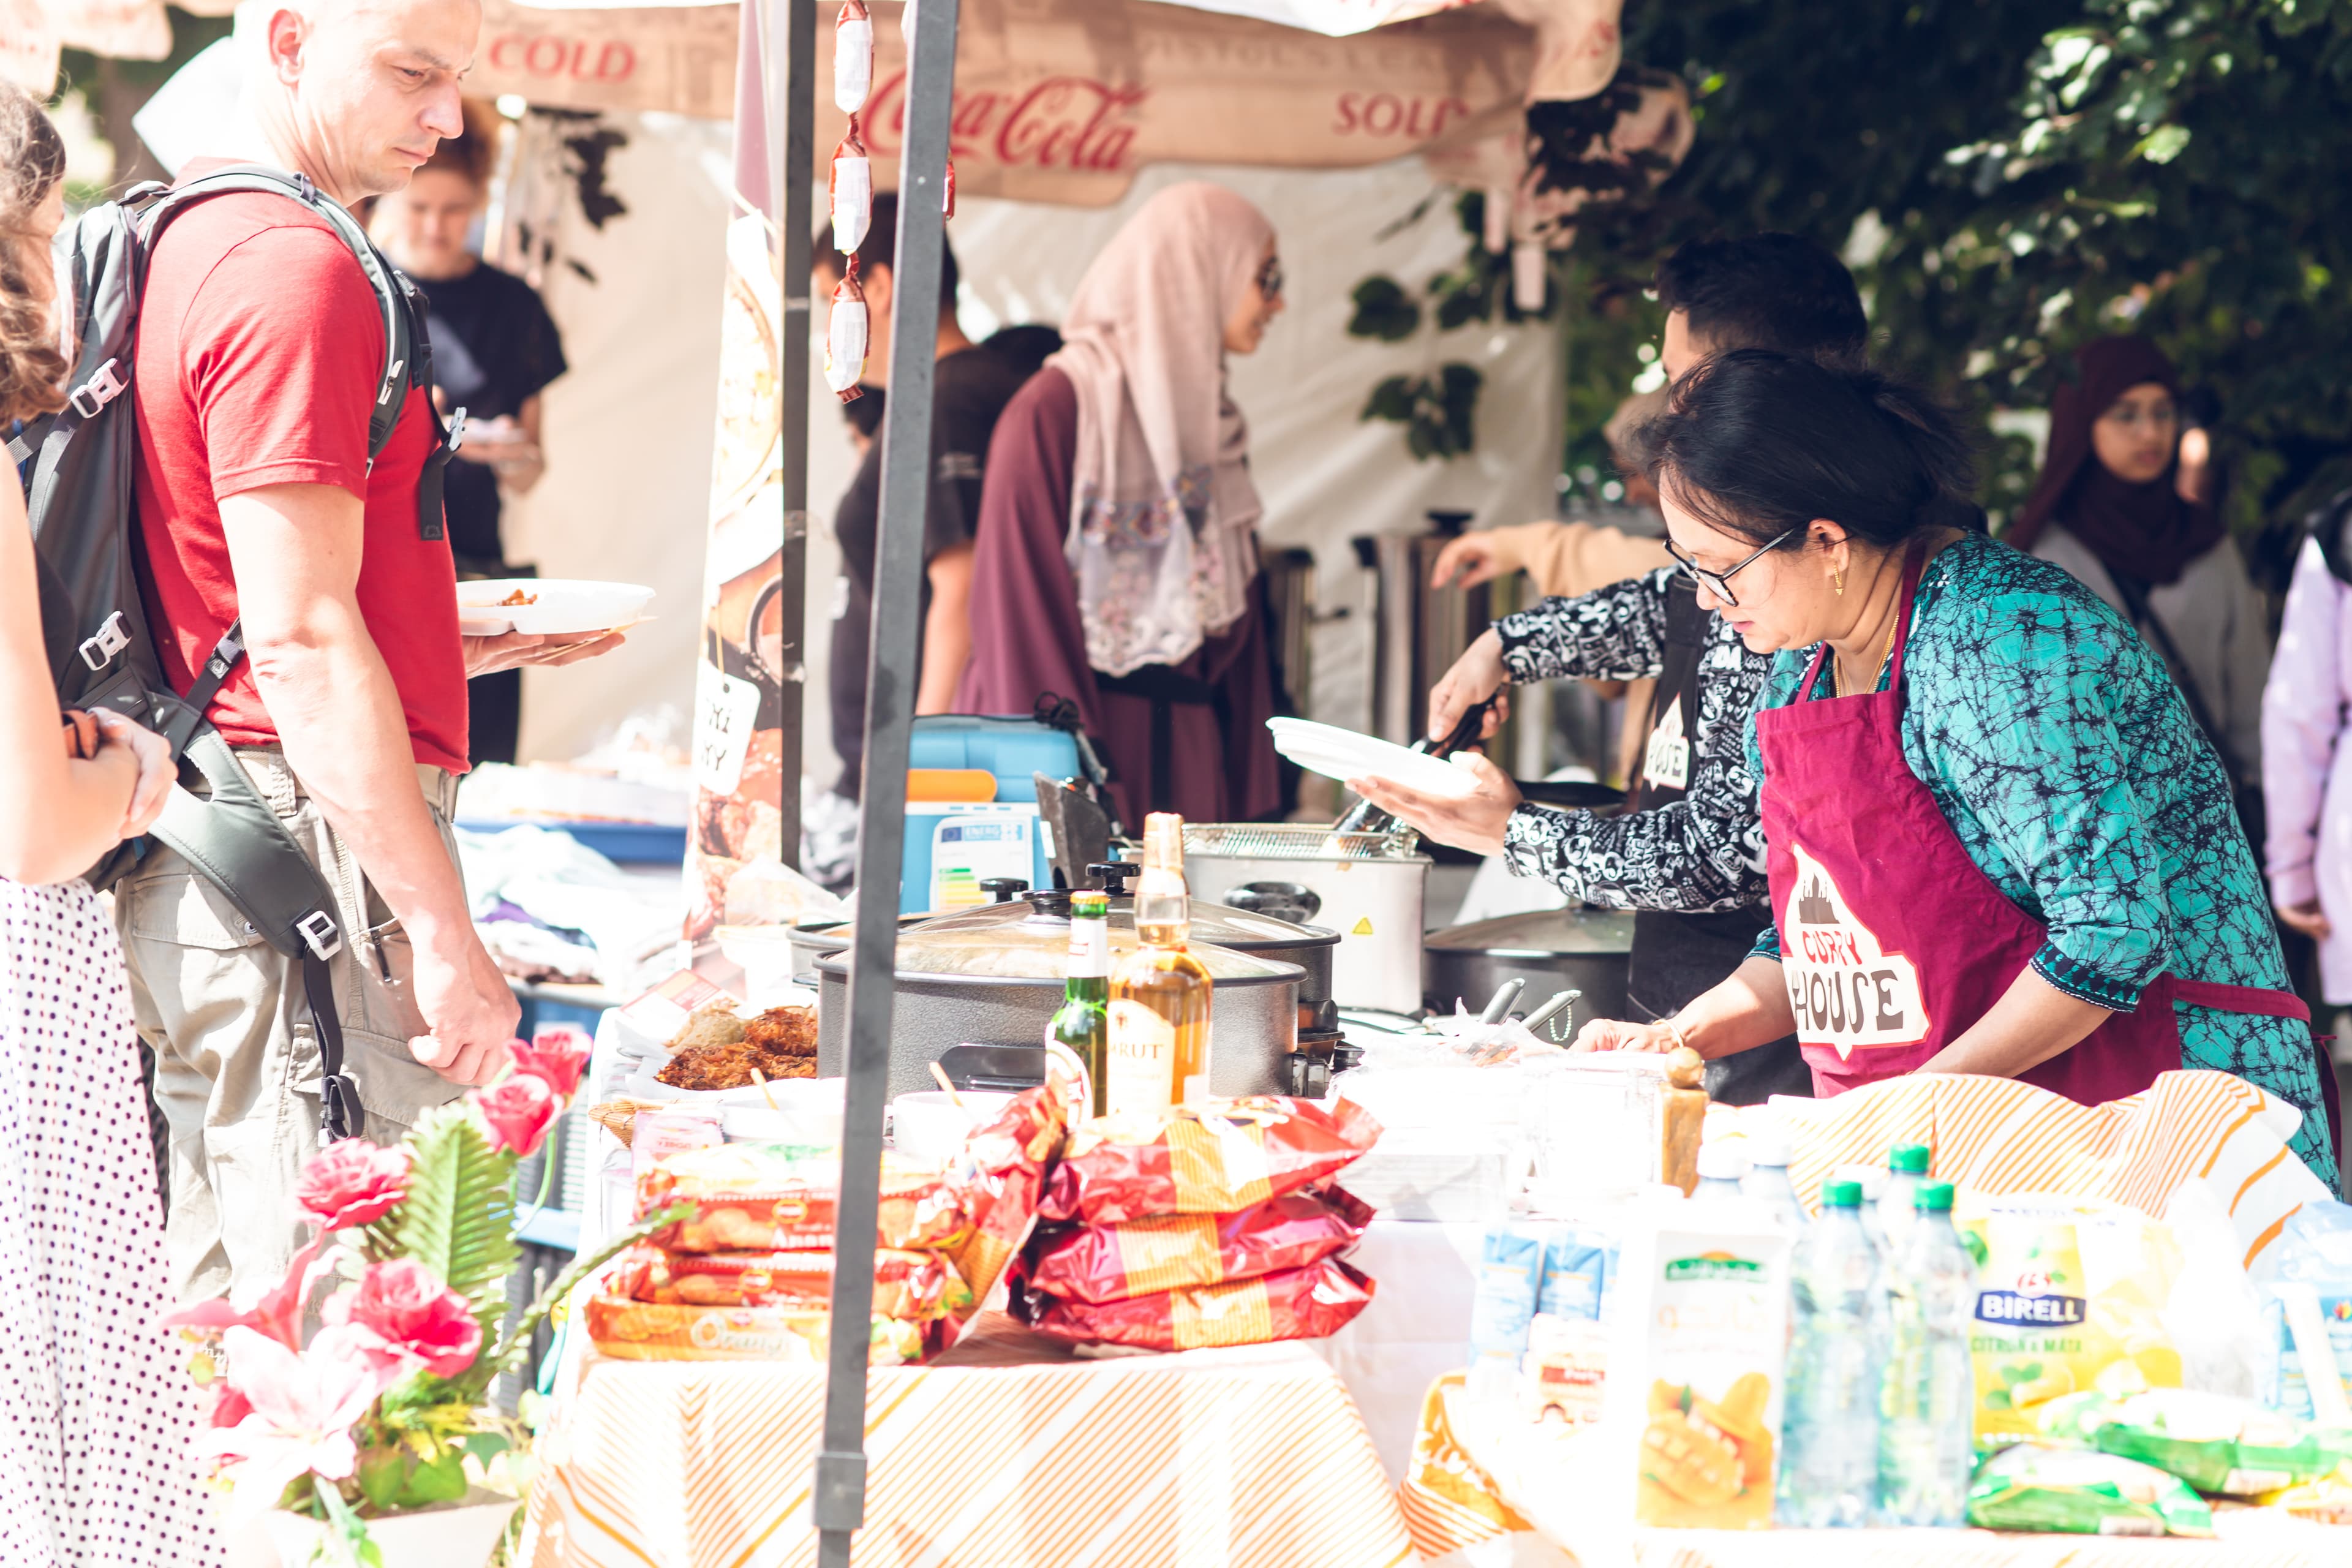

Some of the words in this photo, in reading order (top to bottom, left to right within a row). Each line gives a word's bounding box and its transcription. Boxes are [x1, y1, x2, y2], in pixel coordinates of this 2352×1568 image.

[489, 32, 637, 83] COLD
[1802, 930, 1862, 966] CURRY
[1792, 970, 1903, 1034] HOUSE
[1982, 1294, 2079, 1322] BIRELL
